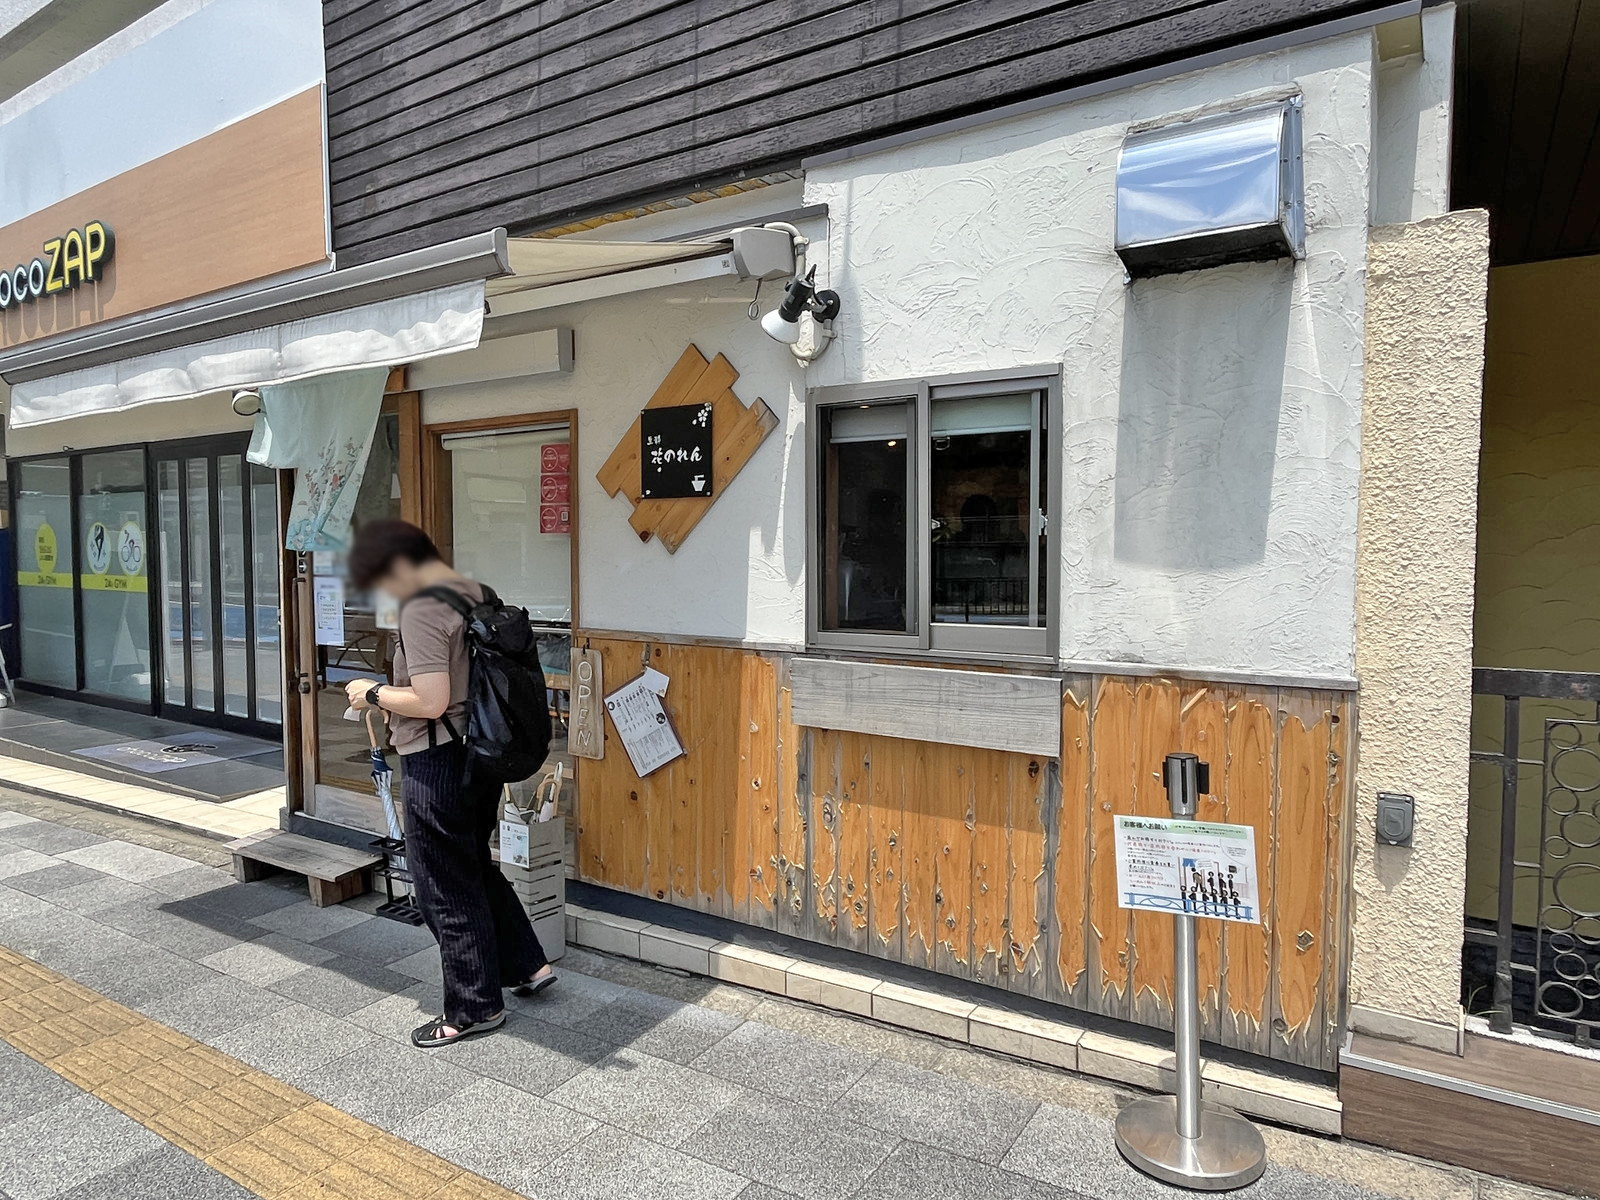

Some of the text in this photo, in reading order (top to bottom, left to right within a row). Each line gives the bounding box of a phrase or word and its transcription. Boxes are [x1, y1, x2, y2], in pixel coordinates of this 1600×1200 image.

[651, 446, 703, 465] 花のれん
[577, 661, 593, 747] OPEN
[1123, 821, 1168, 831] お客様へお願い
